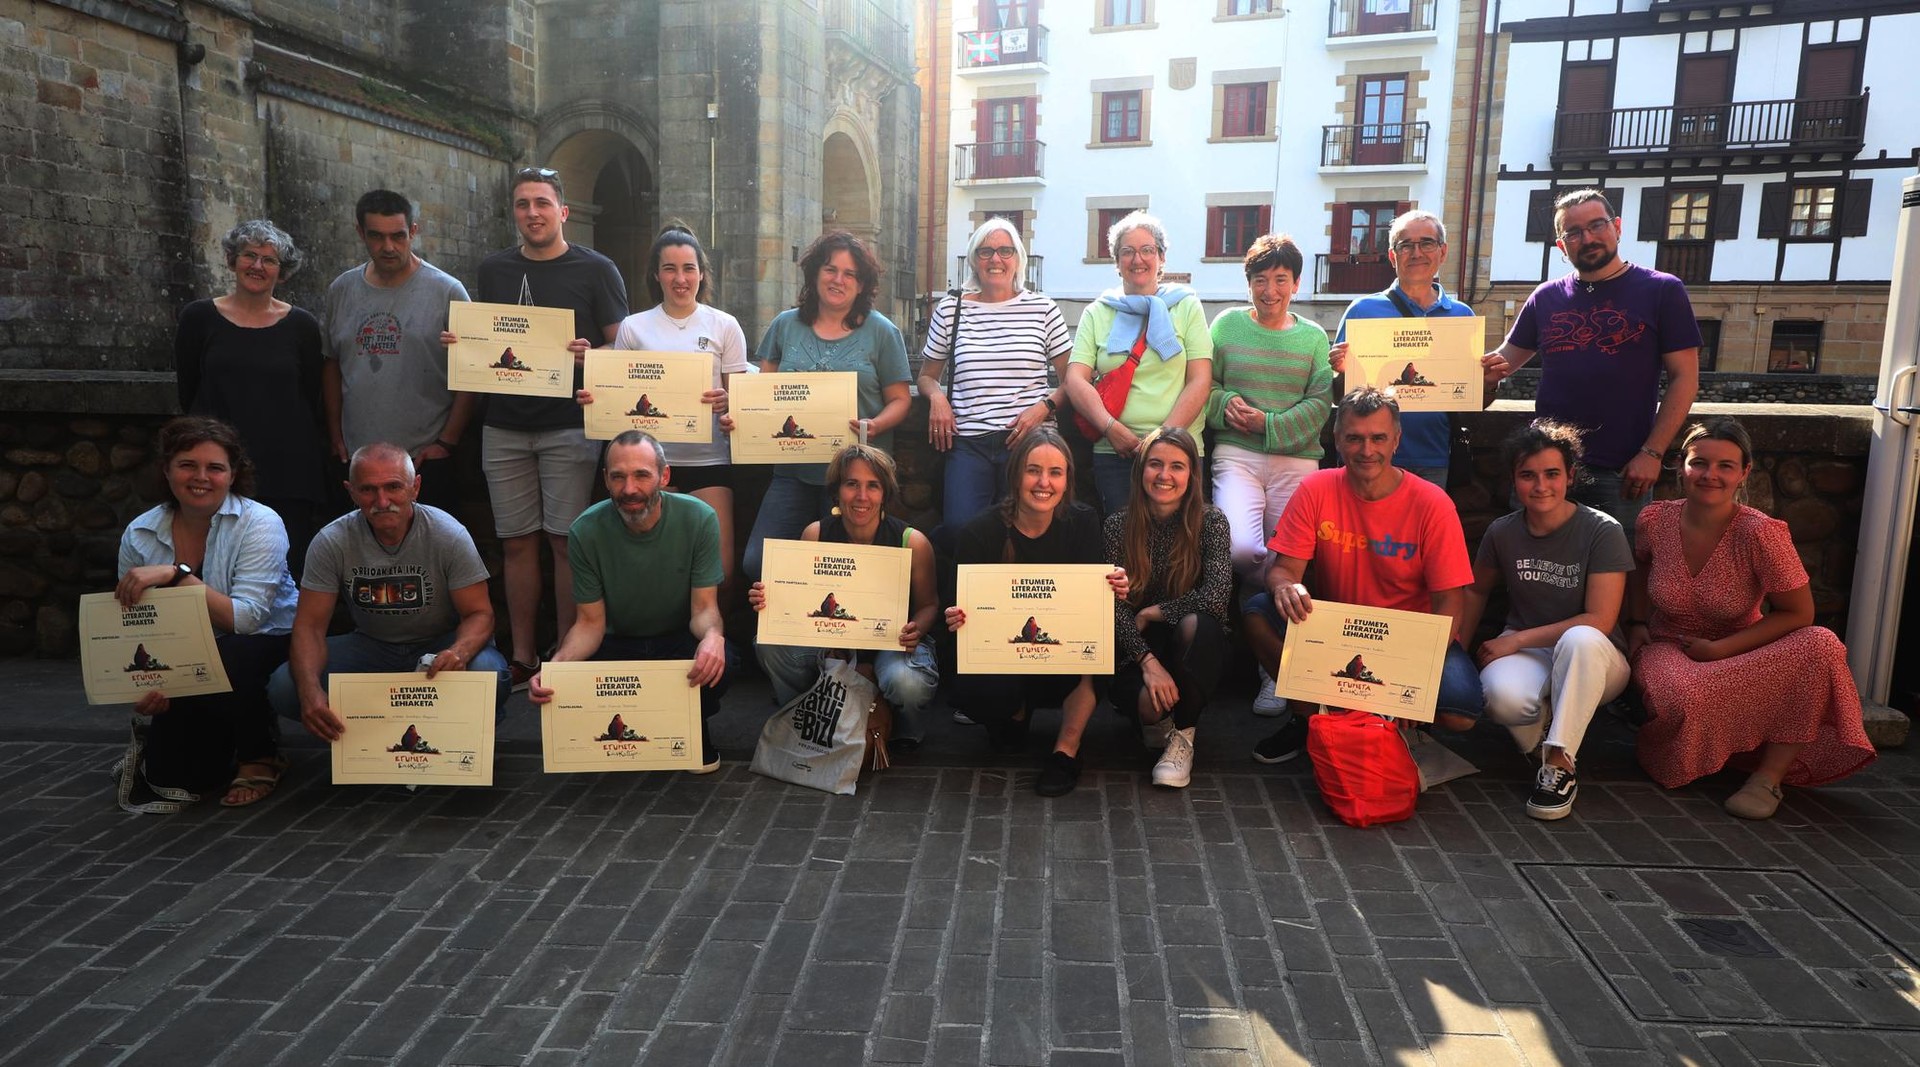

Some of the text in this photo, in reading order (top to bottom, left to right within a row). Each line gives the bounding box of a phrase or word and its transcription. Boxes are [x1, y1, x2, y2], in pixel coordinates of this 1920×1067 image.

[1318, 520, 1418, 560] Superdry
[814, 563, 856, 571] LITERATURA
[1516, 559, 1580, 575] BELIEVE IN
[814, 569, 852, 577] LEHIAKETA
[1518, 571, 1579, 588] YOURSELF
[129, 604, 155, 612] ETUMETA
[122, 612, 158, 620] LITERATURA
[1353, 619, 1388, 628] ETUMETA
[1344, 625, 1389, 635] LITERATURA
[1343, 631, 1383, 641] LEHIAKETA
